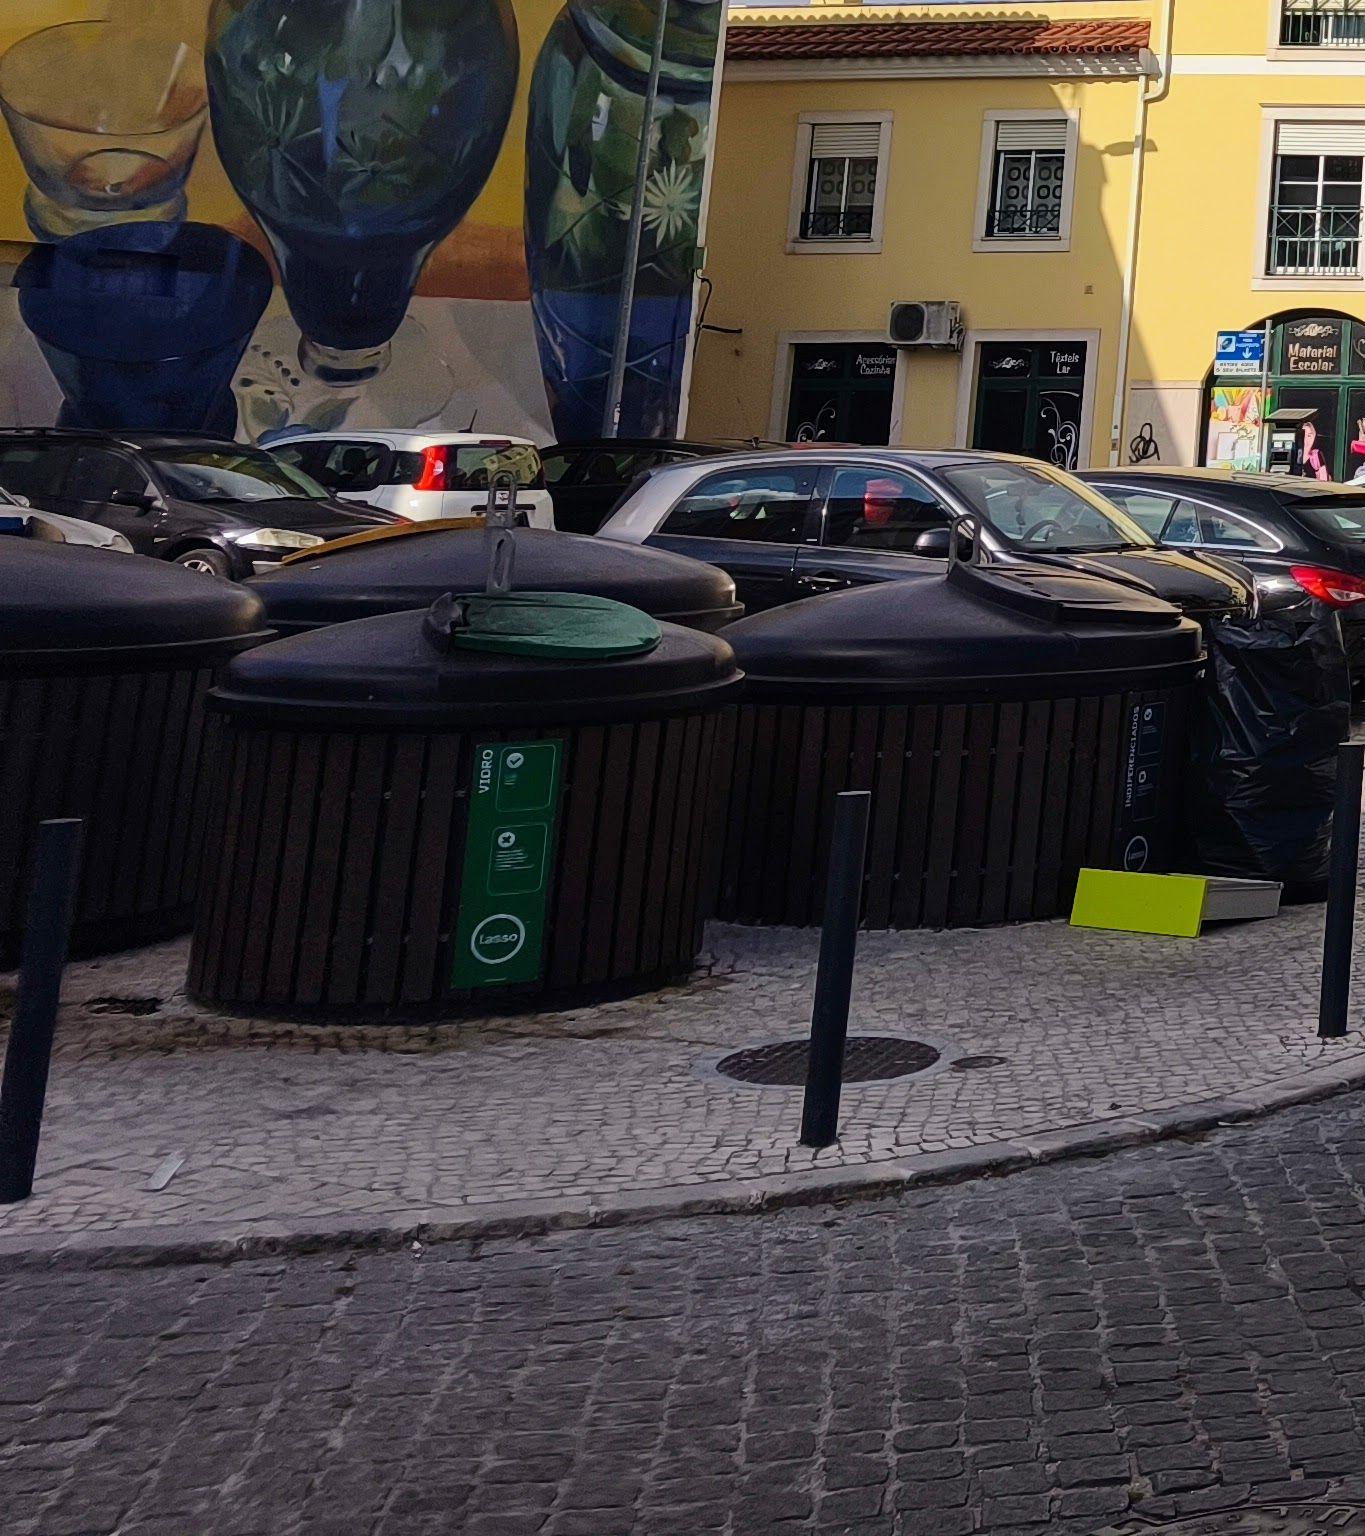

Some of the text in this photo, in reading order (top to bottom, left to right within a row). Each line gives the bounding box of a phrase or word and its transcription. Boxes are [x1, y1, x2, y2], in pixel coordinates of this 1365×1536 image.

[1288, 343, 1338, 359] Material
[1056, 362, 1071, 374] Lar
[1289, 357, 1335, 372] Escolar
[478, 749, 494, 794] VIDRO
